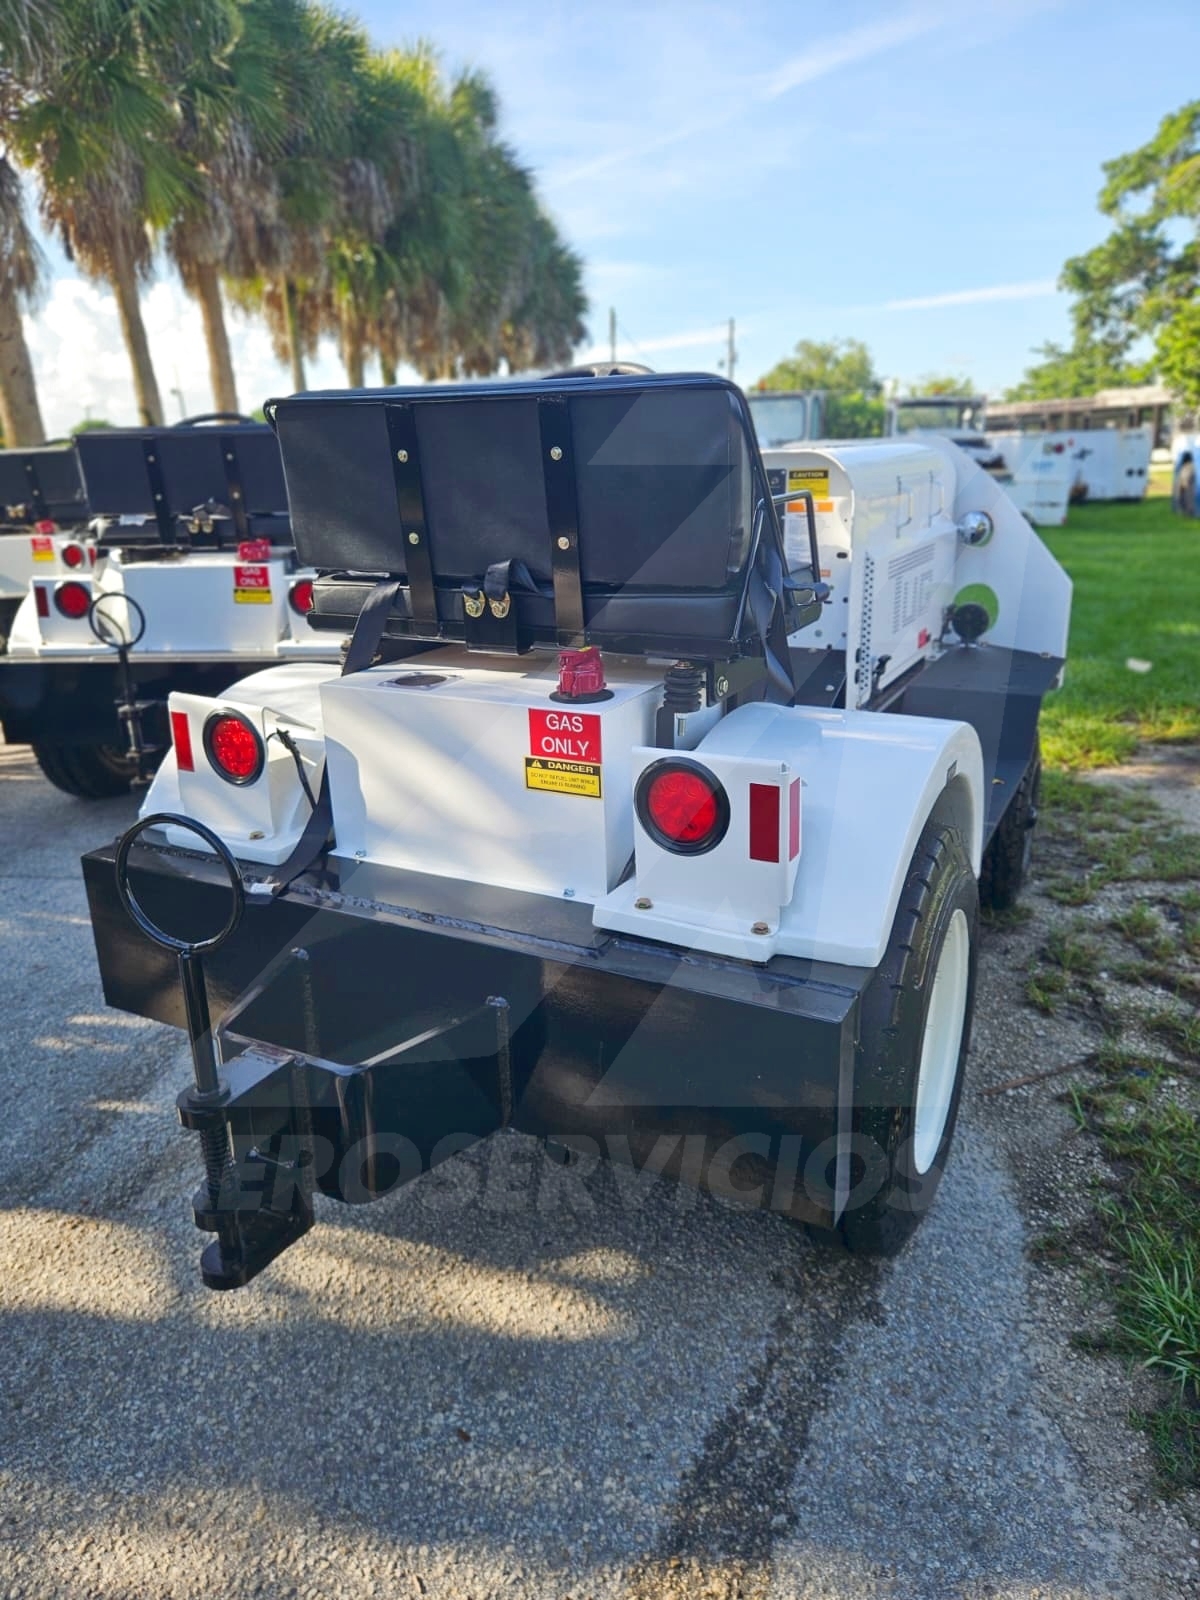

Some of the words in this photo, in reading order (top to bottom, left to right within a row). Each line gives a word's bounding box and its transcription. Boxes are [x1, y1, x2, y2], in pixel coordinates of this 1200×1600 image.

[242, 567, 261, 576] GAS
[240, 577, 264, 586] ONLY
[546, 714, 583, 732] GAS
[542, 737, 589, 756] ONLY
[548, 762, 593, 773] DANGER
